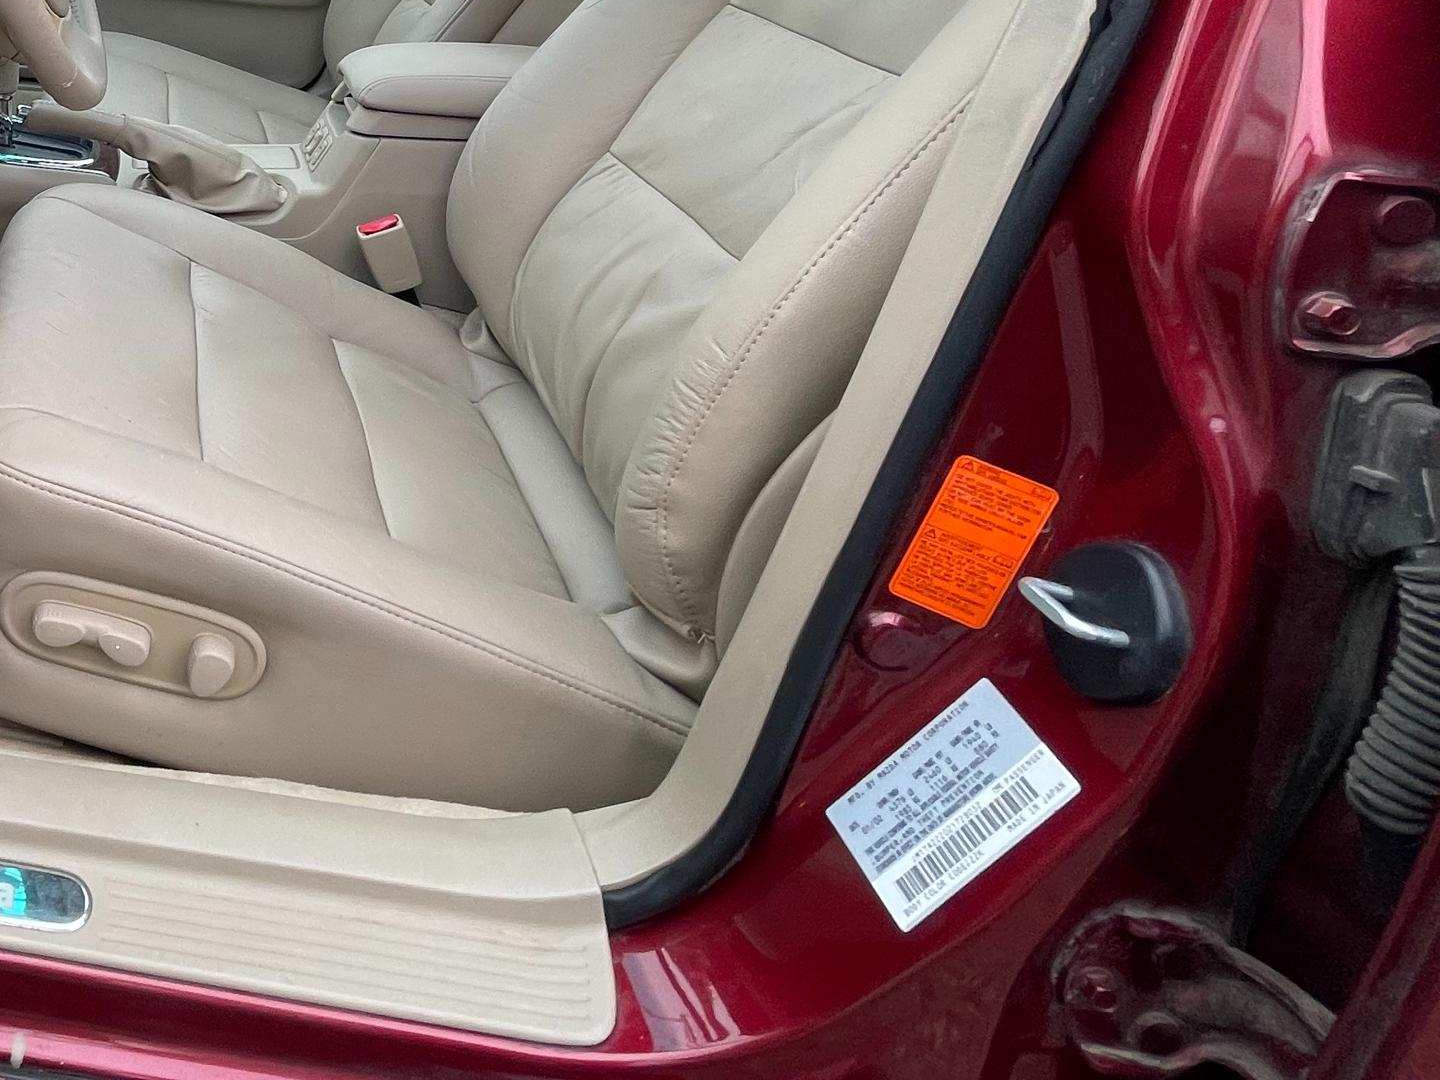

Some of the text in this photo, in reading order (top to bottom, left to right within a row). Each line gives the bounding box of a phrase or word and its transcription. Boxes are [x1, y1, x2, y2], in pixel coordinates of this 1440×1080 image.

[877, 759, 898, 779] MAZDA
[899, 740, 921, 760] MOTOR
[923, 700, 968, 740] CORPORATION
[1006, 814, 1026, 832] MADE
[1041, 781, 1066, 803] JAPAN
